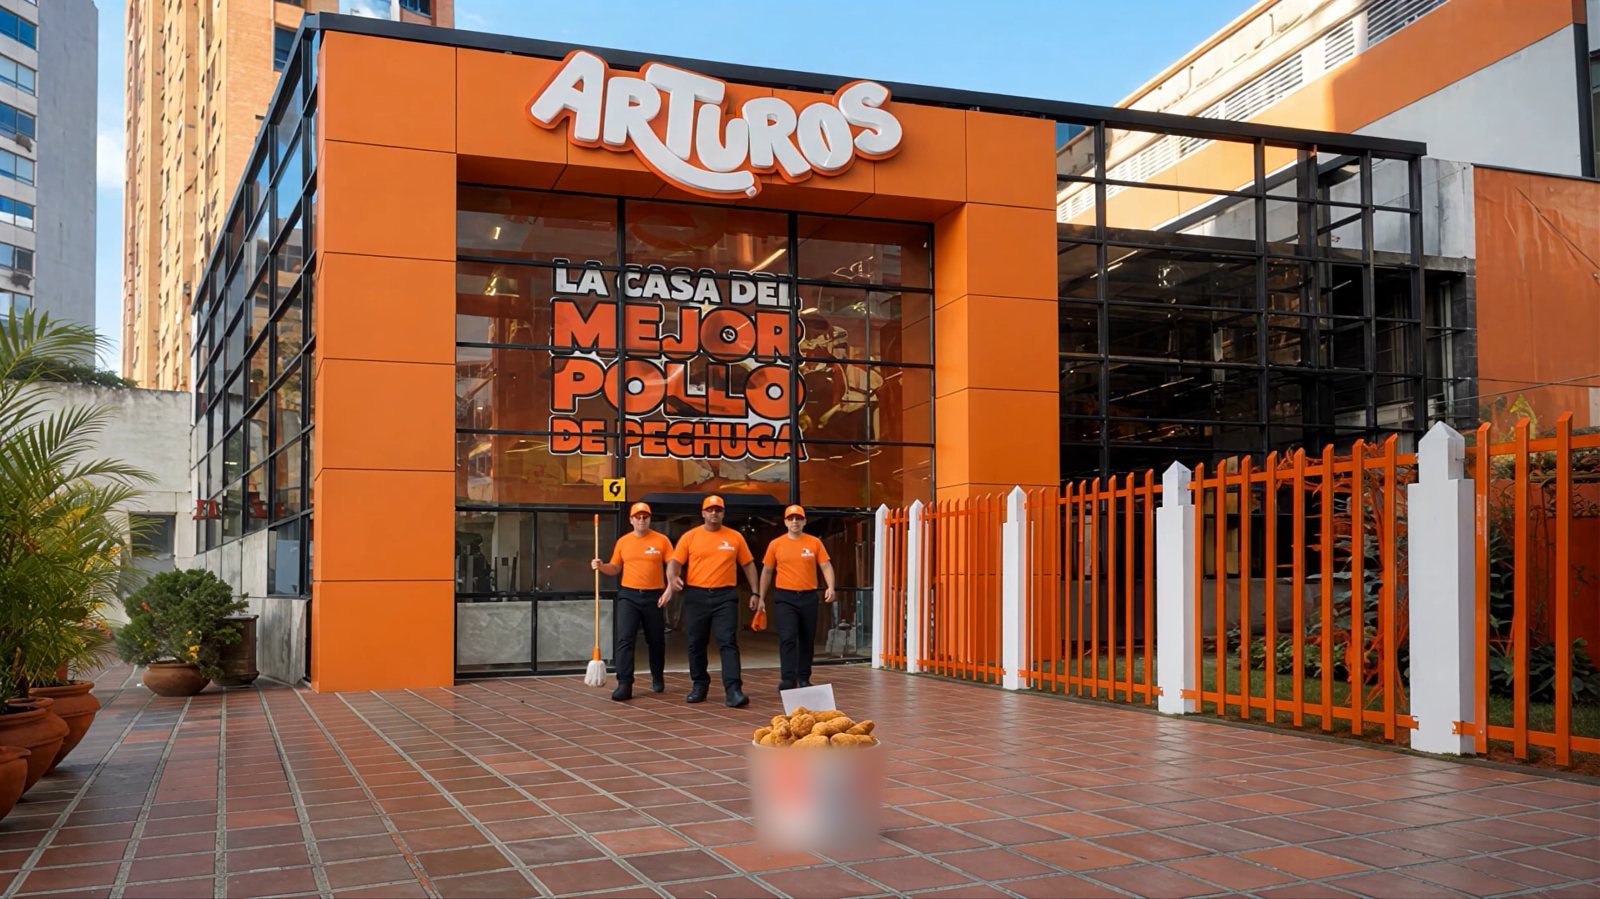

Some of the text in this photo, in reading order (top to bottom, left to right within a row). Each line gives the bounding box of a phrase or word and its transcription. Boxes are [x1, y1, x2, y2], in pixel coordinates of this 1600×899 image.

[529, 50, 903, 196] ARTUROS
[554, 260, 799, 307] LA CASA DEL
[552, 299, 802, 362] MEJOR
[552, 357, 805, 419] POLLO
[552, 417, 806, 460] DE PECHUGA
